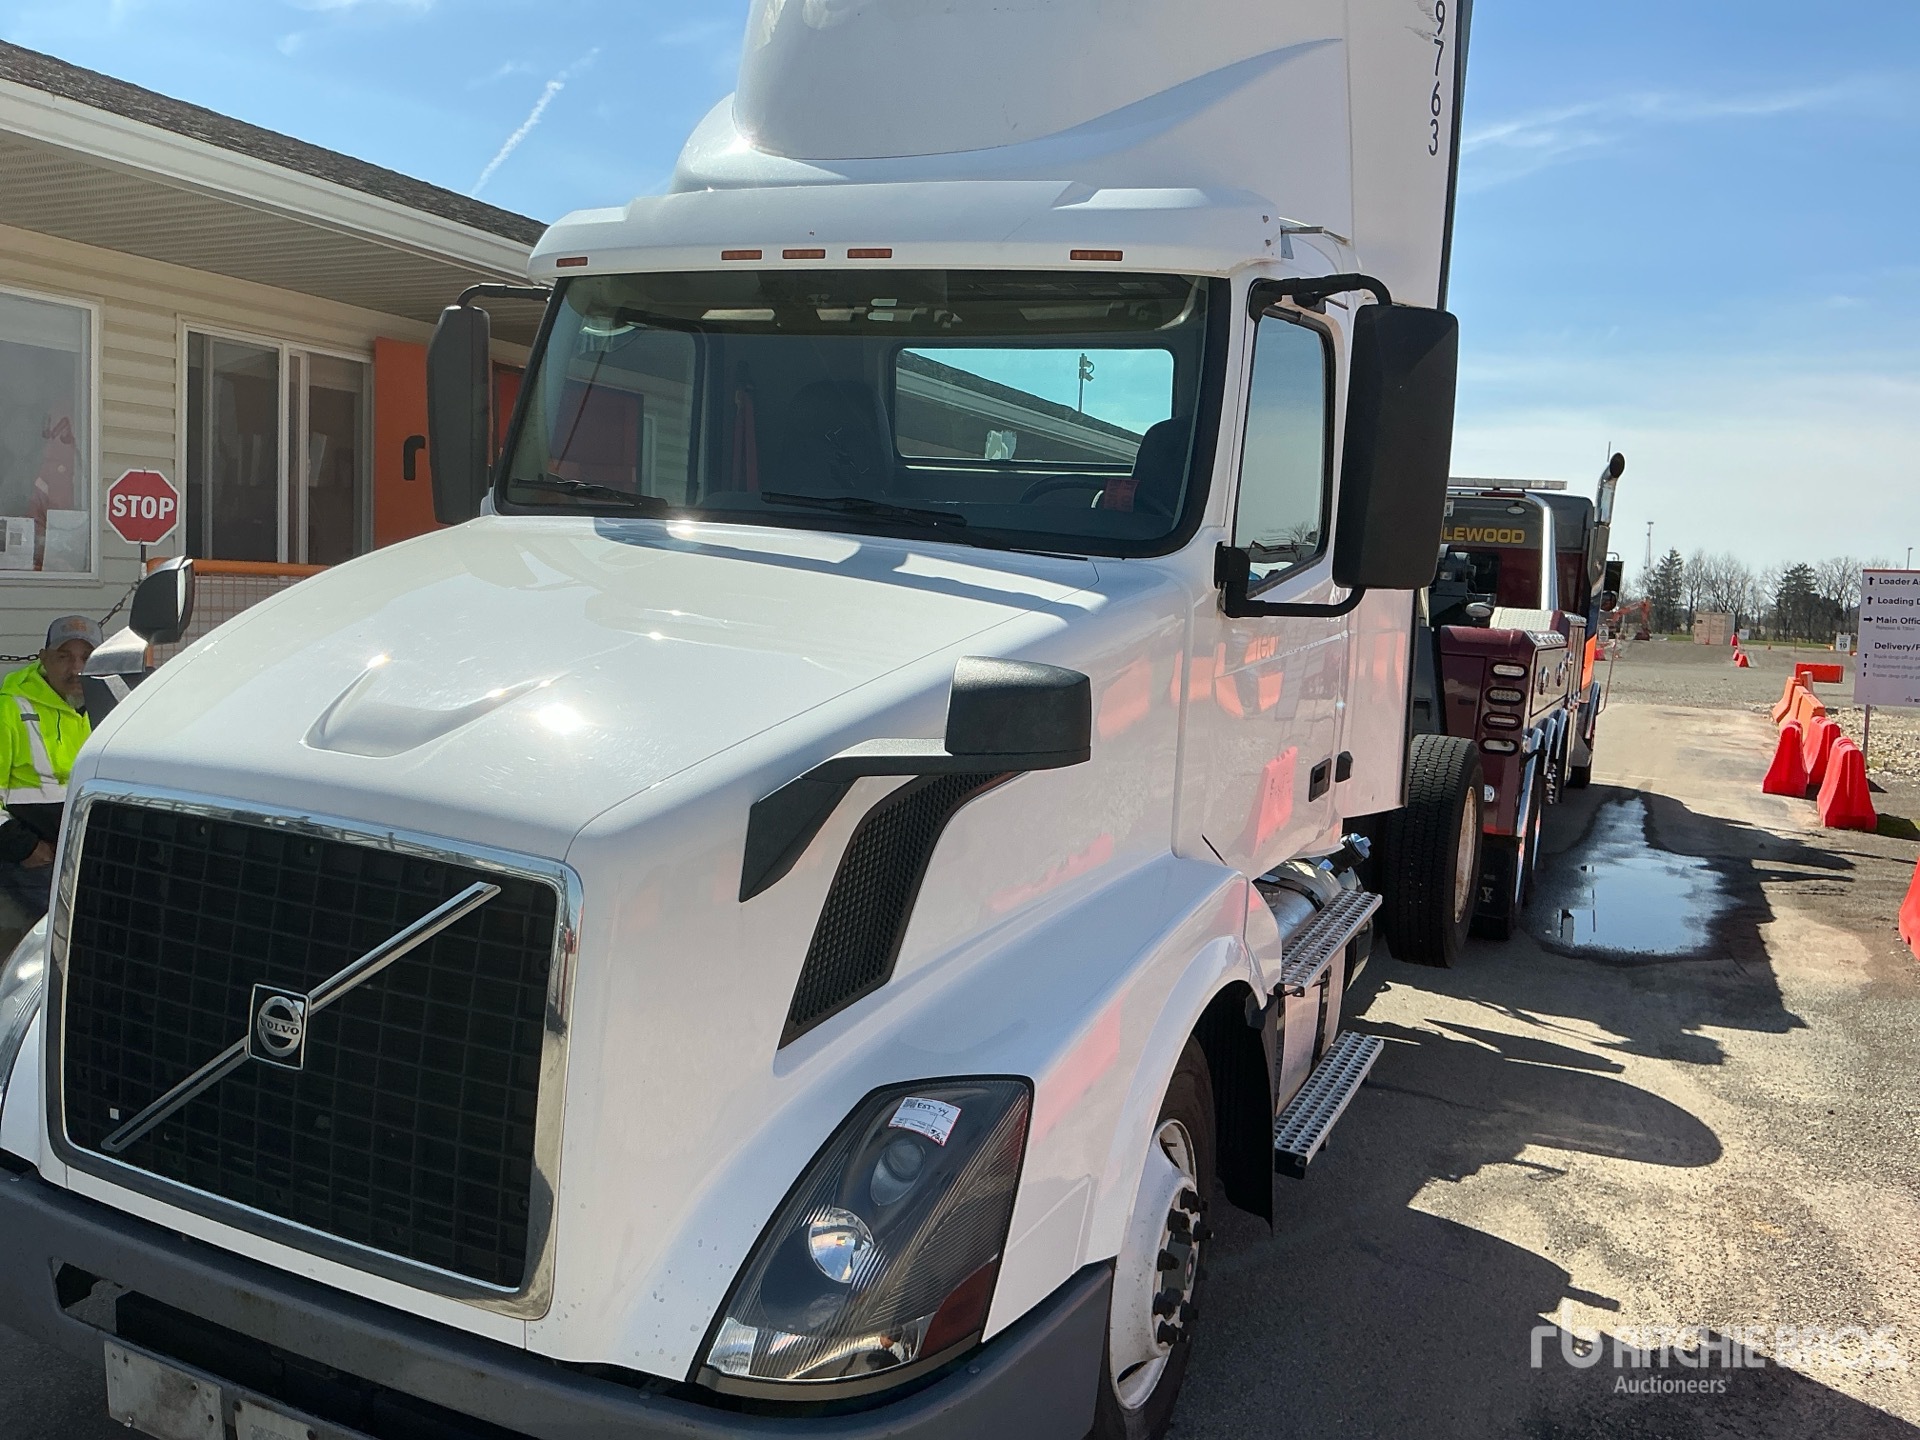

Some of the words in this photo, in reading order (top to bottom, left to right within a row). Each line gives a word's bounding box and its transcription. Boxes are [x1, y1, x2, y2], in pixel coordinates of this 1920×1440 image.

[111, 493, 175, 520] STOP
[1443, 526, 1526, 544] LEWOOD
[1879, 577, 1910, 586] Loader
[1912, 578, 1920, 586] A
[1877, 596, 1914, 607] Loading
[1876, 616, 1898, 624] Main
[260, 1018, 299, 1035] VOLVO
